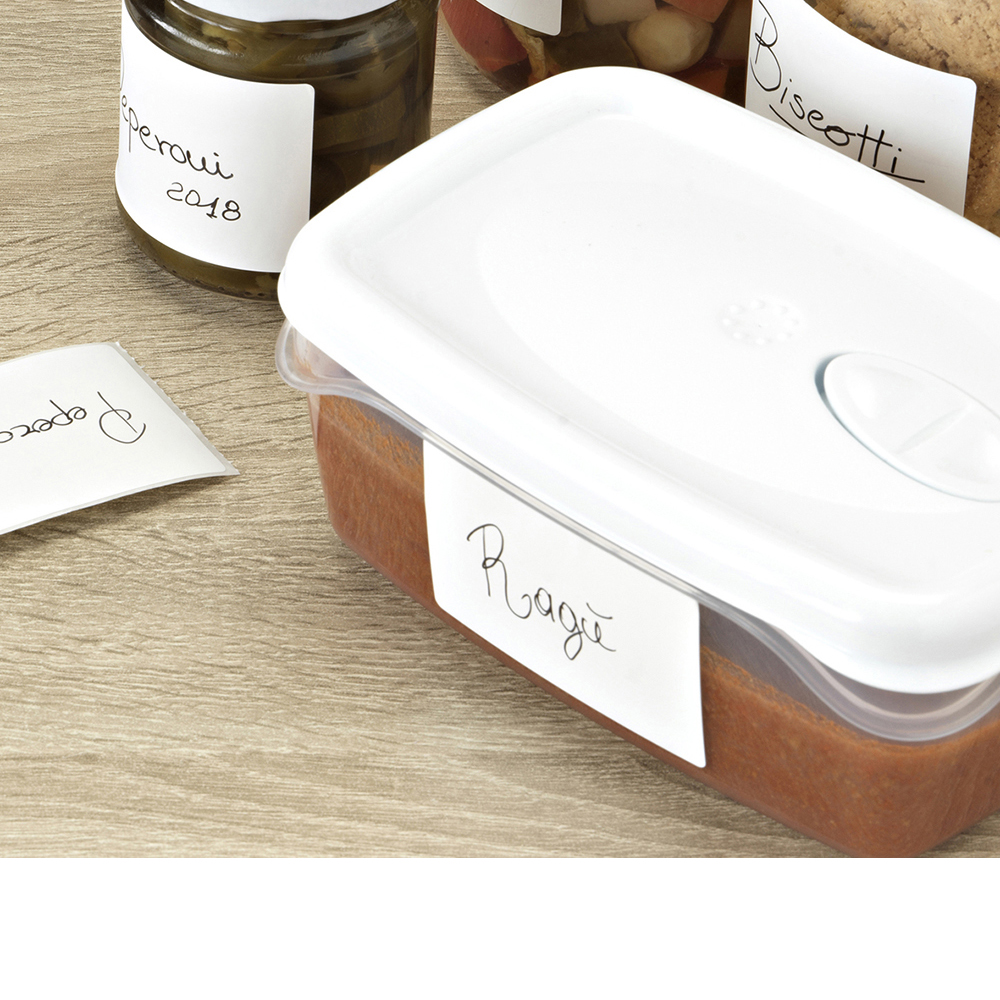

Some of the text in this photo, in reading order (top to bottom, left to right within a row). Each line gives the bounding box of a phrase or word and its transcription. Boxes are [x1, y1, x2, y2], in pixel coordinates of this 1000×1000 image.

[749, 0, 903, 174] Biscotti
[120, 93, 235, 180] eperoni
[166, 181, 242, 222] 2018
